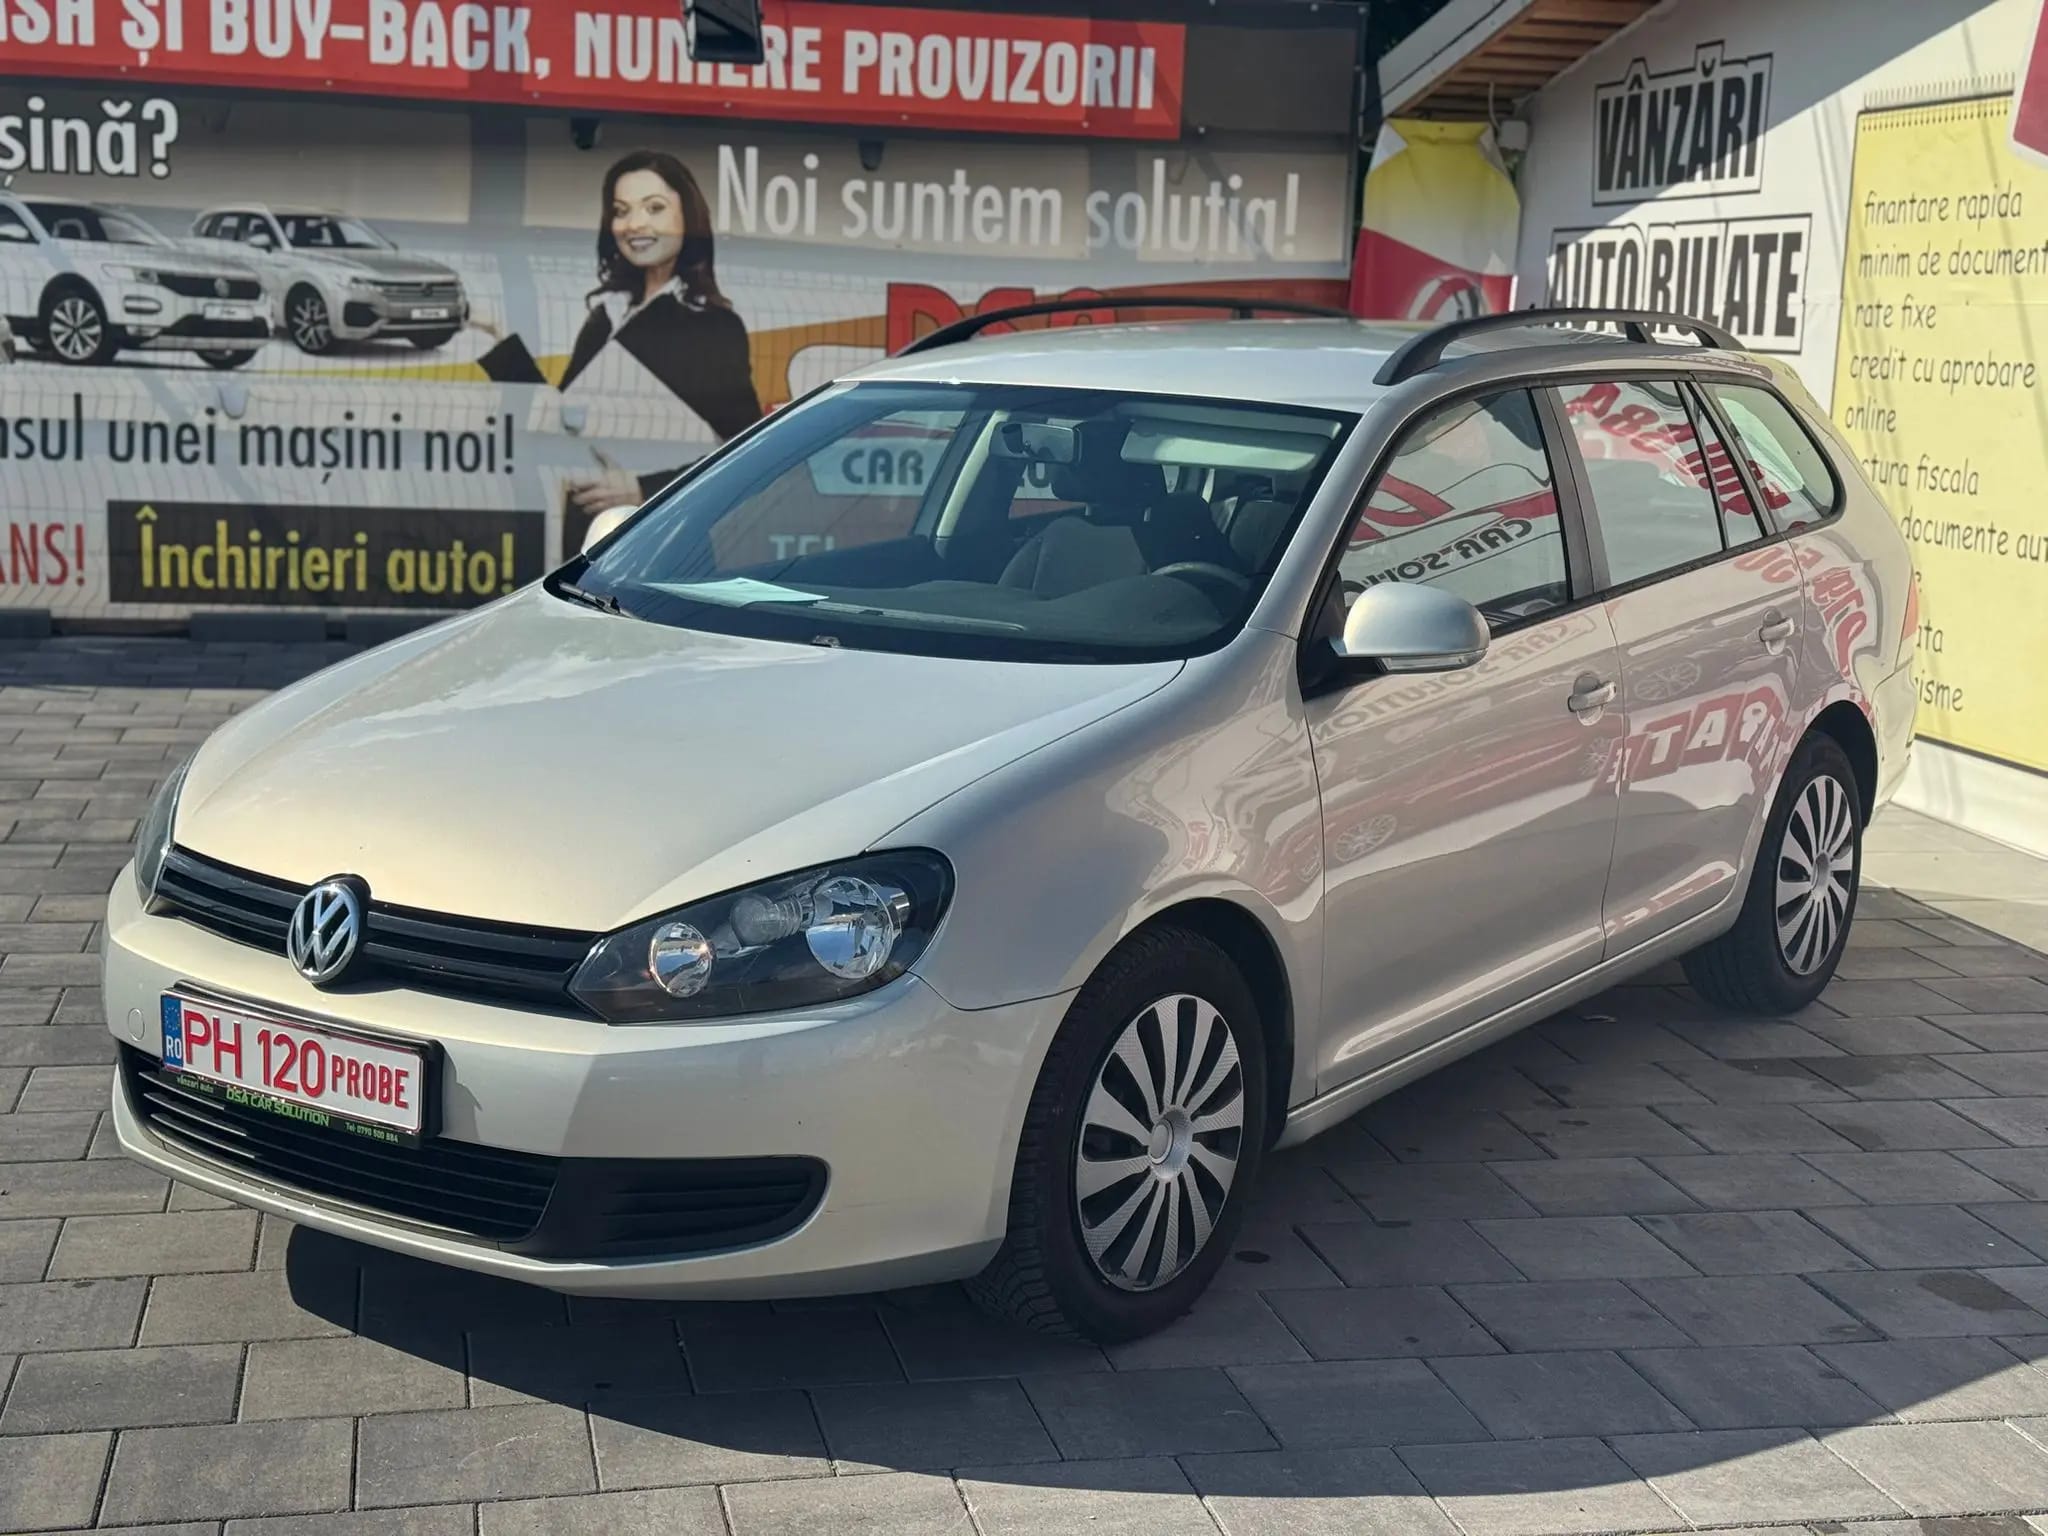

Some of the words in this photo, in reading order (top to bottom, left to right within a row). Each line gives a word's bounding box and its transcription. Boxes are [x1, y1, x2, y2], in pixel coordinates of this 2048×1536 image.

[0, 0, 95, 46] SH
[842, 29, 1156, 110] PROVIZORII
[1598, 56, 1764, 192] VÂNZĂRI
[717, 145, 819, 237] Noi
[841, 169, 1062, 248] suntem
[1864, 189, 1949, 228] finantare
[1956, 179, 2022, 232] rapida
[1858, 243, 1911, 278] minim
[1917, 240, 1941, 276] de
[1855, 298, 1894, 329] rate
[1901, 293, 1937, 331] fixe
[1850, 347, 1906, 382] credit
[1912, 355, 1934, 383] cu
[1939, 350, 2036, 396] aprobare
[1845, 396, 1897, 433] online
[108, 406, 216, 465] unei
[239, 410, 401, 485] mașini
[425, 413, 515, 475] noi!
[842, 449, 923, 485] CAR
[1862, 453, 1908, 488] tura
[1917, 453, 1979, 496] fiscala
[0, 522, 86, 587] NS!
[135, 504, 367, 594] Închirieri
[387, 531, 515, 596] auto!
[1901, 505, 2010, 556] documente
[1914, 669, 1963, 713] isme
[166, 1035, 182, 1060] RO
[184, 1009, 242, 1080] PH
[257, 1028, 326, 1099] 120
[331, 1054, 410, 1110] PROBE
[250, 1094, 273, 1112] CAR
[274, 1101, 330, 1127] SOLUTION
